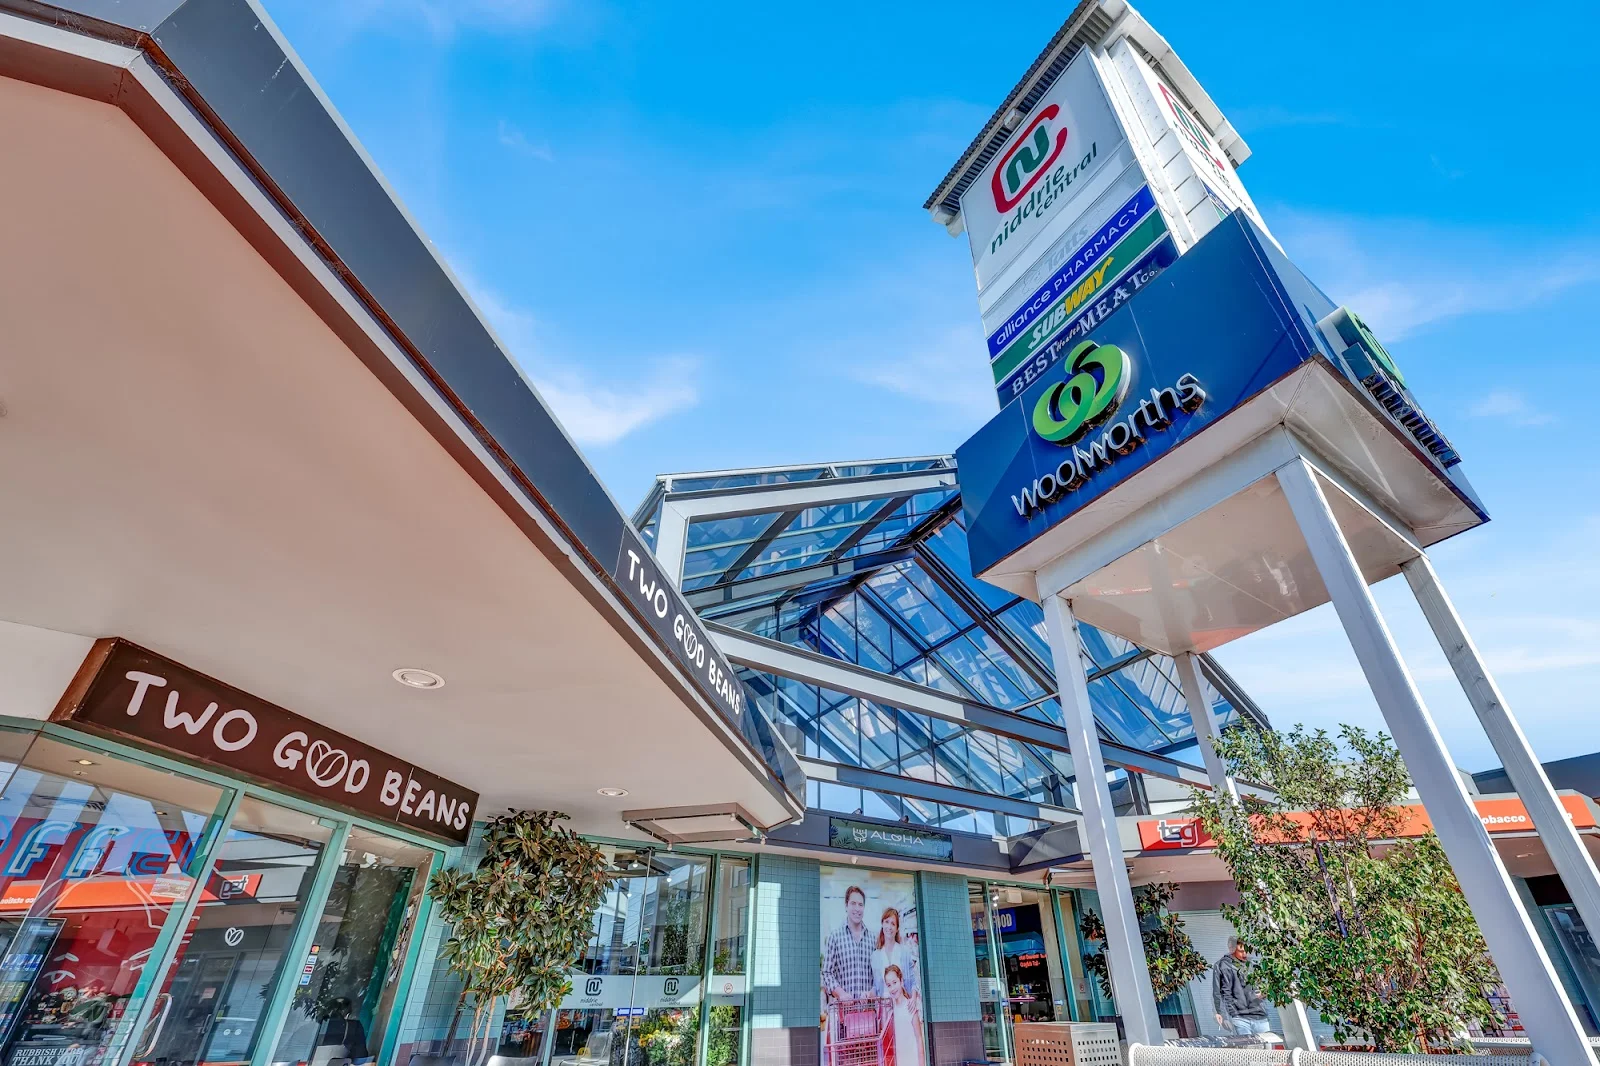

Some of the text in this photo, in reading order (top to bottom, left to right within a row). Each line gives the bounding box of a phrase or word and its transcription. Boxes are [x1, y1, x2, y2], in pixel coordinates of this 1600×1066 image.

[991, 165, 1064, 255] niddrie
[1035, 141, 1097, 218] central
[996, 202, 1139, 346] alliance PHARMACY
[1028, 256, 1114, 349] SUBWAY
[1012, 341, 1058, 395] BEST
[1078, 269, 1143, 337] MEAT
[1011, 372, 1203, 518] woolworths
[628, 549, 668, 618] TWO
[708, 657, 741, 715] BEANS
[125, 671, 258, 751] TWO
[380, 769, 470, 831] BEANS
[1157, 820, 1198, 847] tsg
[1482, 815, 1526, 824] obacco
[12, 1056, 54, 1066] THANK
[15, 1048, 57, 1056] RUBBISH
